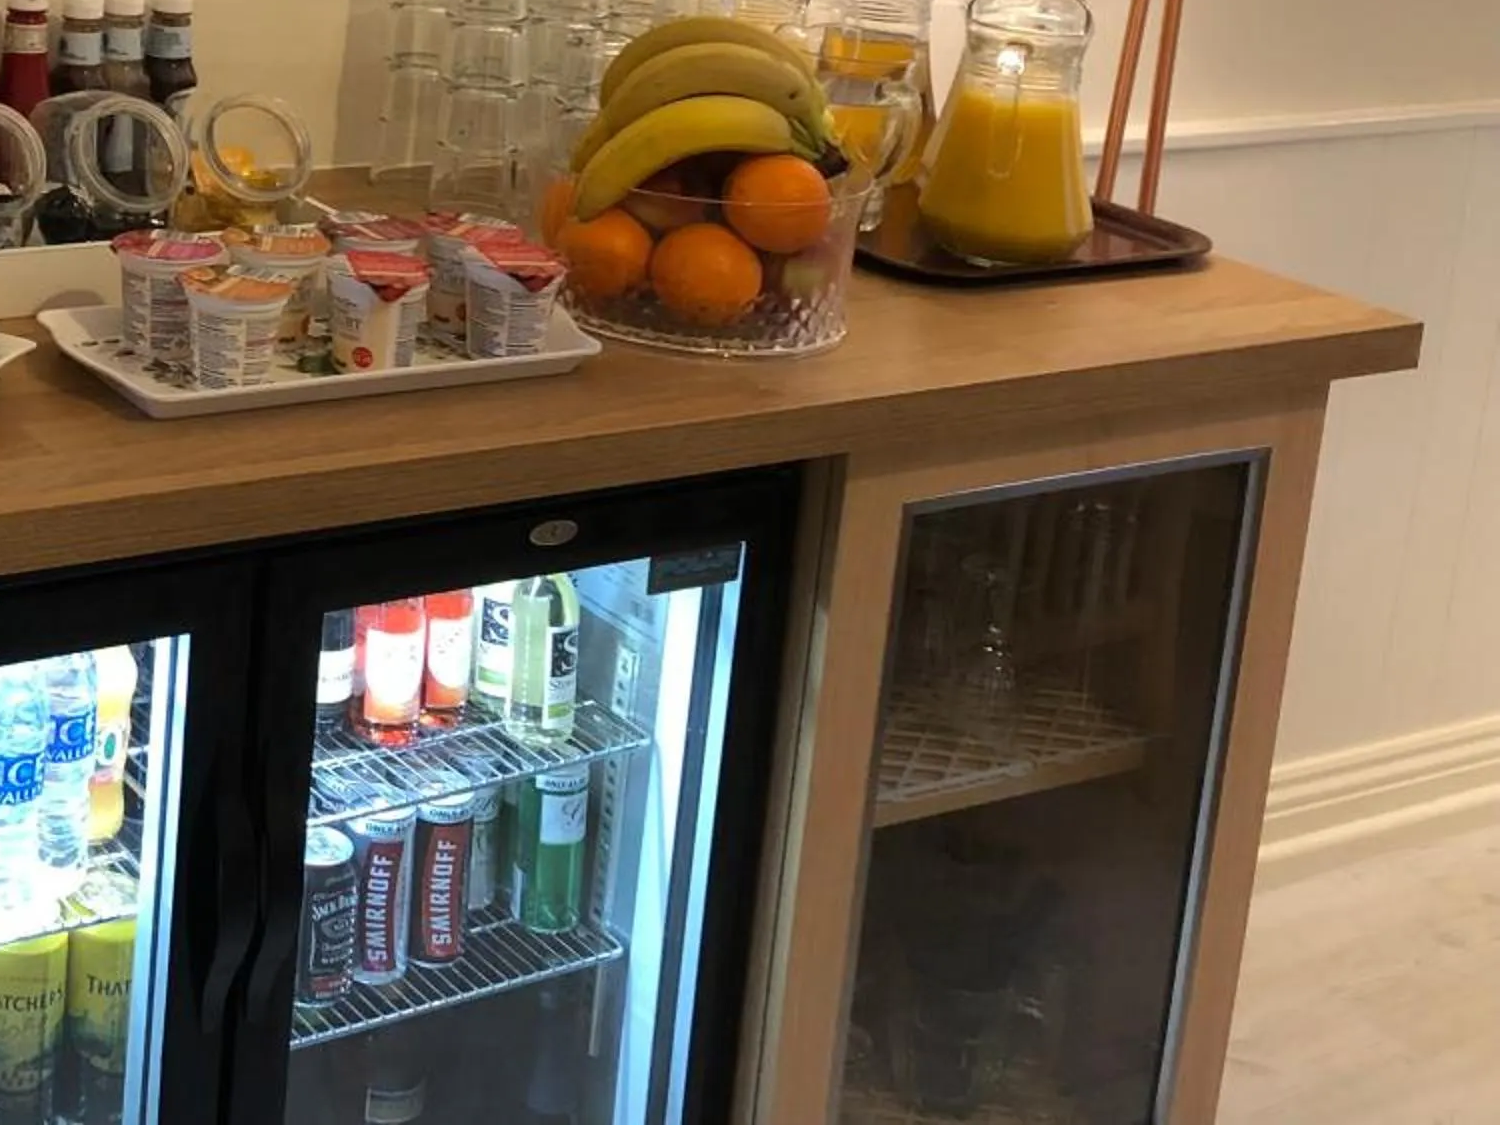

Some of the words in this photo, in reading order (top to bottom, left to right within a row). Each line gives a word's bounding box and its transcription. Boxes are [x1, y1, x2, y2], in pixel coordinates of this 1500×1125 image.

[46, 741, 96, 764] VALLE
[364, 852, 394, 964] SMIRNOFF
[429, 839, 458, 948] SMIRNOFF
